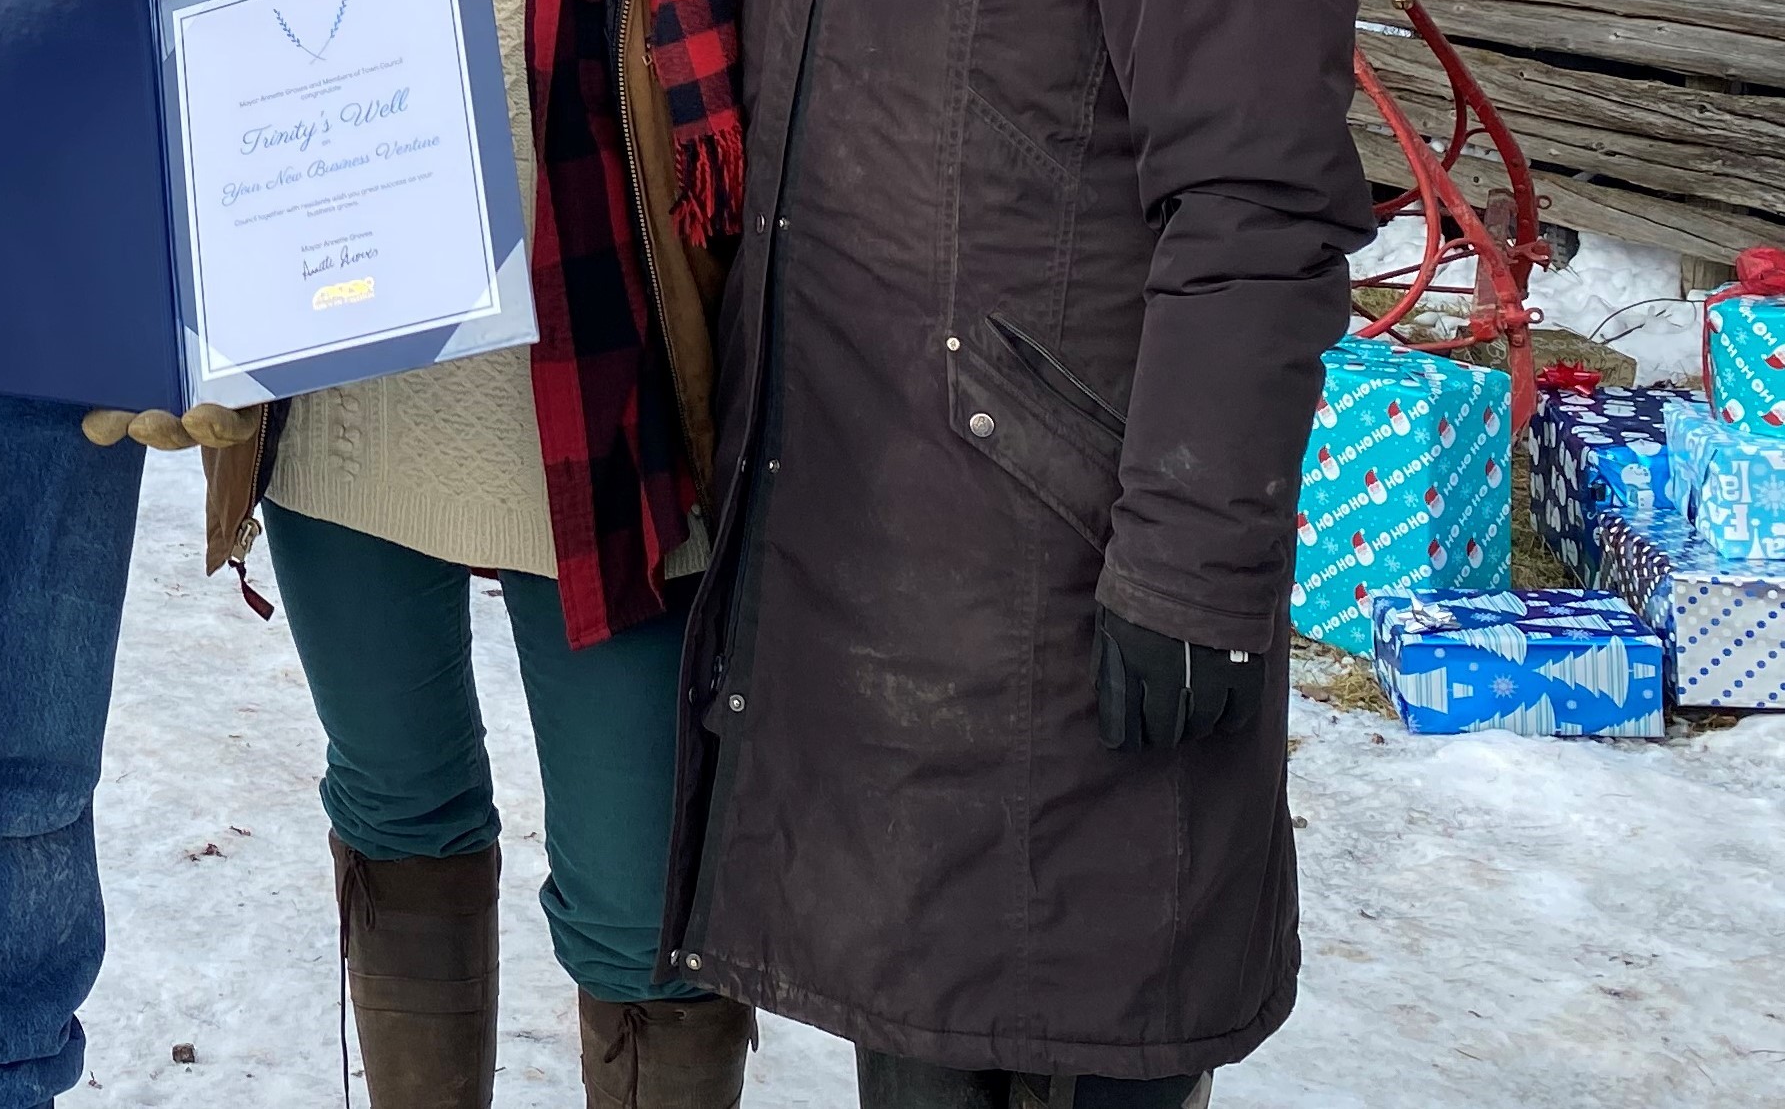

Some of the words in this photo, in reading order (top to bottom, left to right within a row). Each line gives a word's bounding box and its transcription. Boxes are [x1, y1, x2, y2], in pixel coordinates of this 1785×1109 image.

[239, 97, 258, 108] Mayor
[309, 80, 322, 89] and
[322, 73, 353, 85] Members
[354, 68, 361, 77] of
[361, 64, 379, 74] Town
[379, 58, 404, 70] Council
[240, 110, 332, 156] Trinity's
[340, 87, 410, 127] Well
[221, 181, 261, 207] Your
[266, 166, 302, 190] New
[307, 154, 370, 179] Business
[376, 135, 440, 161] Venture
[258, 208, 285, 221] together
[286, 202, 300, 213] with
[331, 192, 347, 203] wish
[347, 189, 361, 200] you
[361, 184, 380, 196] great
[380, 177, 406, 191] success
[407, 176, 416, 185] as
[417, 171, 434, 183] your
[307, 205, 336, 218] business
[301, 240, 323, 253] Mayor
[323, 235, 348, 247] Annette
[1334, 393, 1354, 413] HO
[1352, 383, 1370, 401] HO
[1408, 399, 1430, 420] HO
[1454, 403, 1470, 426] HO
[1469, 384, 1482, 405] HO
[1337, 445, 1356, 465] HO
[1355, 436, 1373, 454] HO
[1371, 424, 1392, 443] HO
[1444, 473, 1459, 496] HO
[1457, 454, 1472, 475] HO
[1470, 432, 1486, 455] HO
[1384, 469, 1404, 489] HO
[1402, 459, 1422, 477] HO
[1419, 444, 1441, 466] HO
[1315, 512, 1334, 532] HO
[1332, 503, 1350, 521] HO
[1348, 492, 1369, 510] HO
[1371, 531, 1391, 551] HO
[1389, 522, 1408, 540] HO
[1406, 511, 1429, 529] HO
[1445, 524, 1460, 548] HO
[1459, 505, 1473, 526] HO
[1471, 484, 1488, 506] HO
[1482, 523, 1497, 547] HO
[1496, 503, 1510, 526] HO
[1304, 573, 1321, 592] HO
[1320, 564, 1338, 581] HO
[1336, 553, 1356, 572] HO
[1409, 564, 1432, 582] HO
[1454, 565, 1470, 587] HO
[1322, 616, 1340, 633] HO
[1338, 606, 1358, 623] HO
